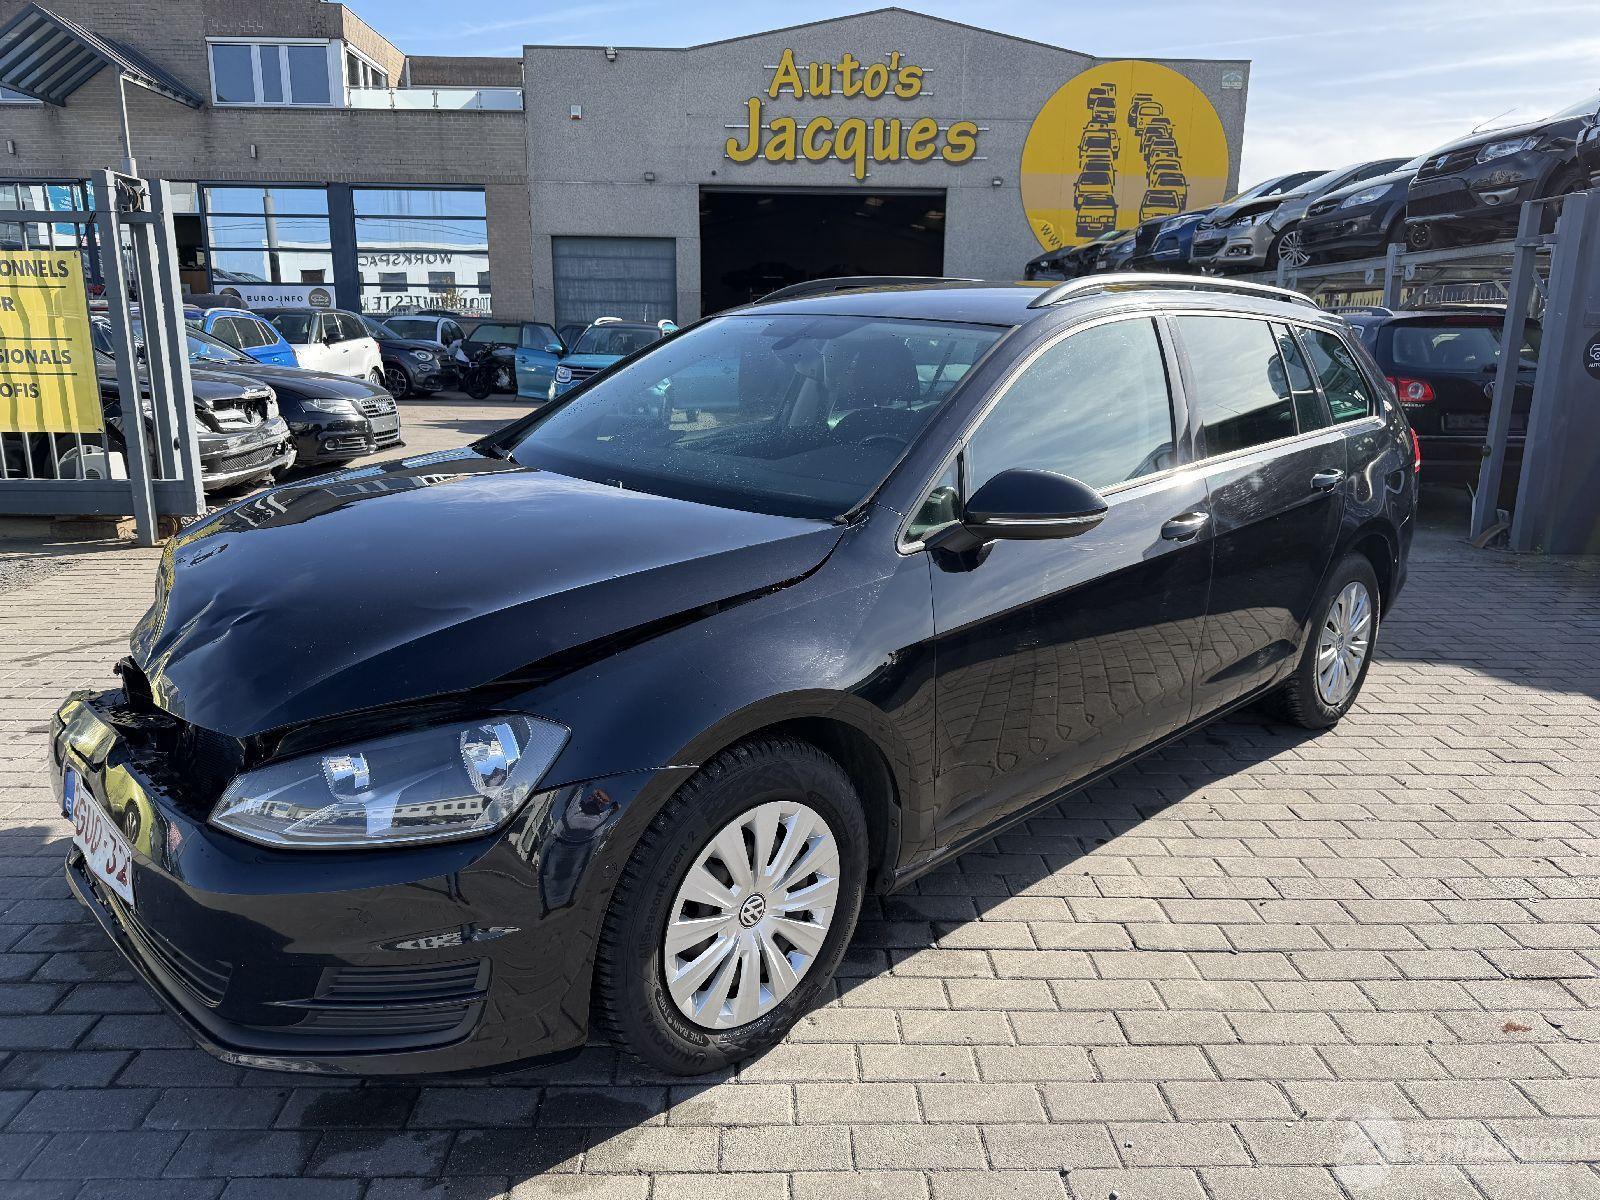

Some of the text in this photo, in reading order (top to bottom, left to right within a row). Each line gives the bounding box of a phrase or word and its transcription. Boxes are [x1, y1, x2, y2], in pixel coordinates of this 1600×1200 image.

[768, 48, 923, 98] Auto's
[726, 97, 978, 180] Jacques
[672, 1019, 689, 1037] RAIN
[690, 1034, 704, 1044] THE
